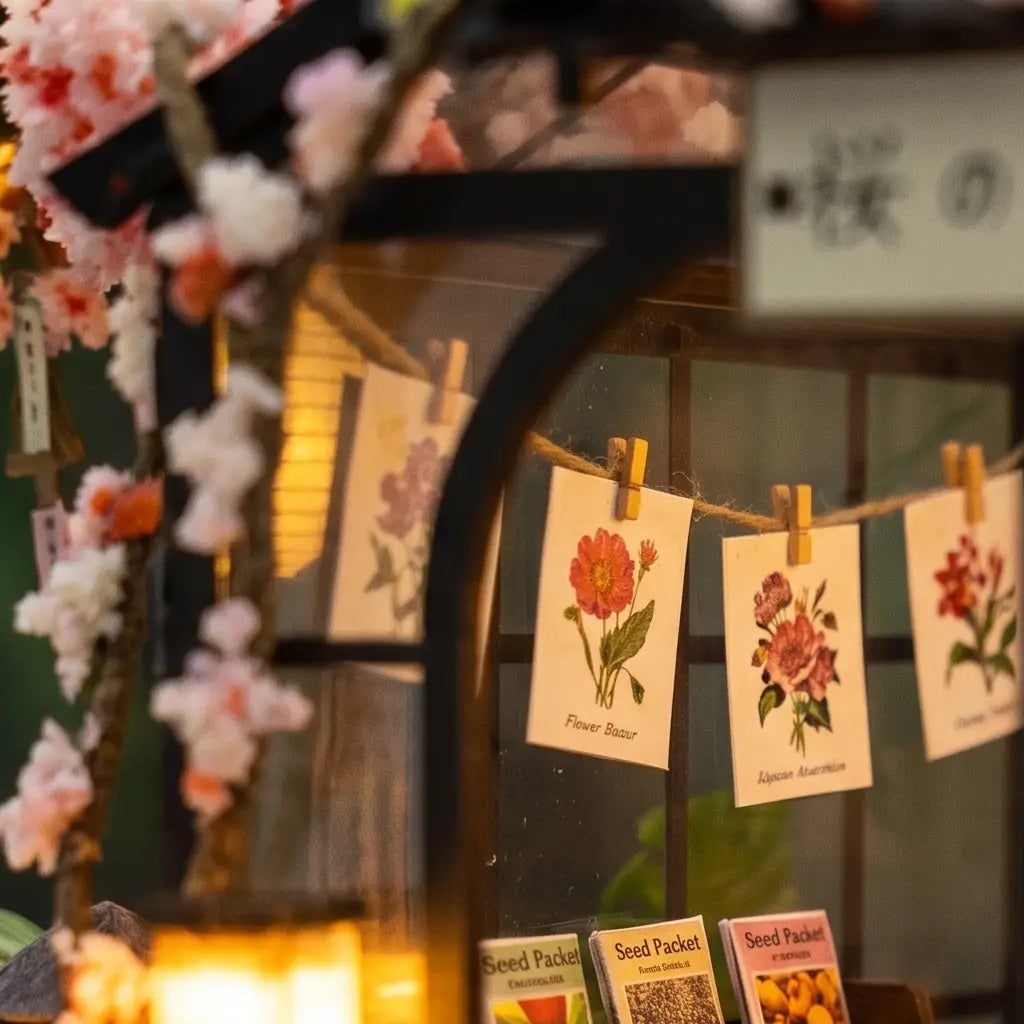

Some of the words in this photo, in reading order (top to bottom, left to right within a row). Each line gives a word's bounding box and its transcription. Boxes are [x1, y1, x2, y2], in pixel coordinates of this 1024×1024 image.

[615, 939, 652, 961] Seed
[652, 934, 702, 956] Packet
[745, 927, 781, 949] Seed
[783, 924, 826, 945] Packet
[480, 950, 530, 975] Seed
[532, 946, 581, 969] Packet
